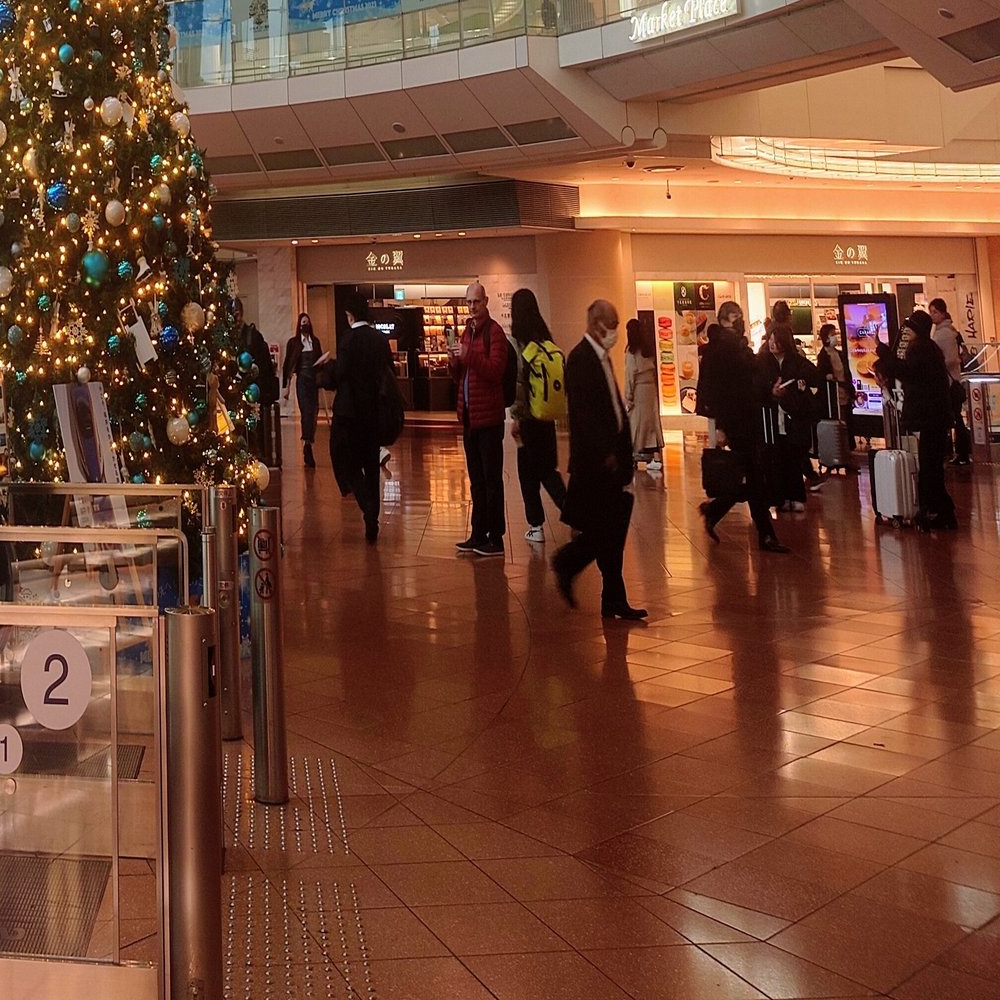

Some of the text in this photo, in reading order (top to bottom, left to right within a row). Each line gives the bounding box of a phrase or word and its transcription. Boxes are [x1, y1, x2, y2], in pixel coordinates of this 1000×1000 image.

[628, 1, 682, 41] Market
[365, 251, 404, 267] 金の翼
[833, 244, 868, 261] 金の翼
[964, 292, 978, 339] HARIE
[43, 653, 70, 706] 2
[0, 736, 9, 763] 1
